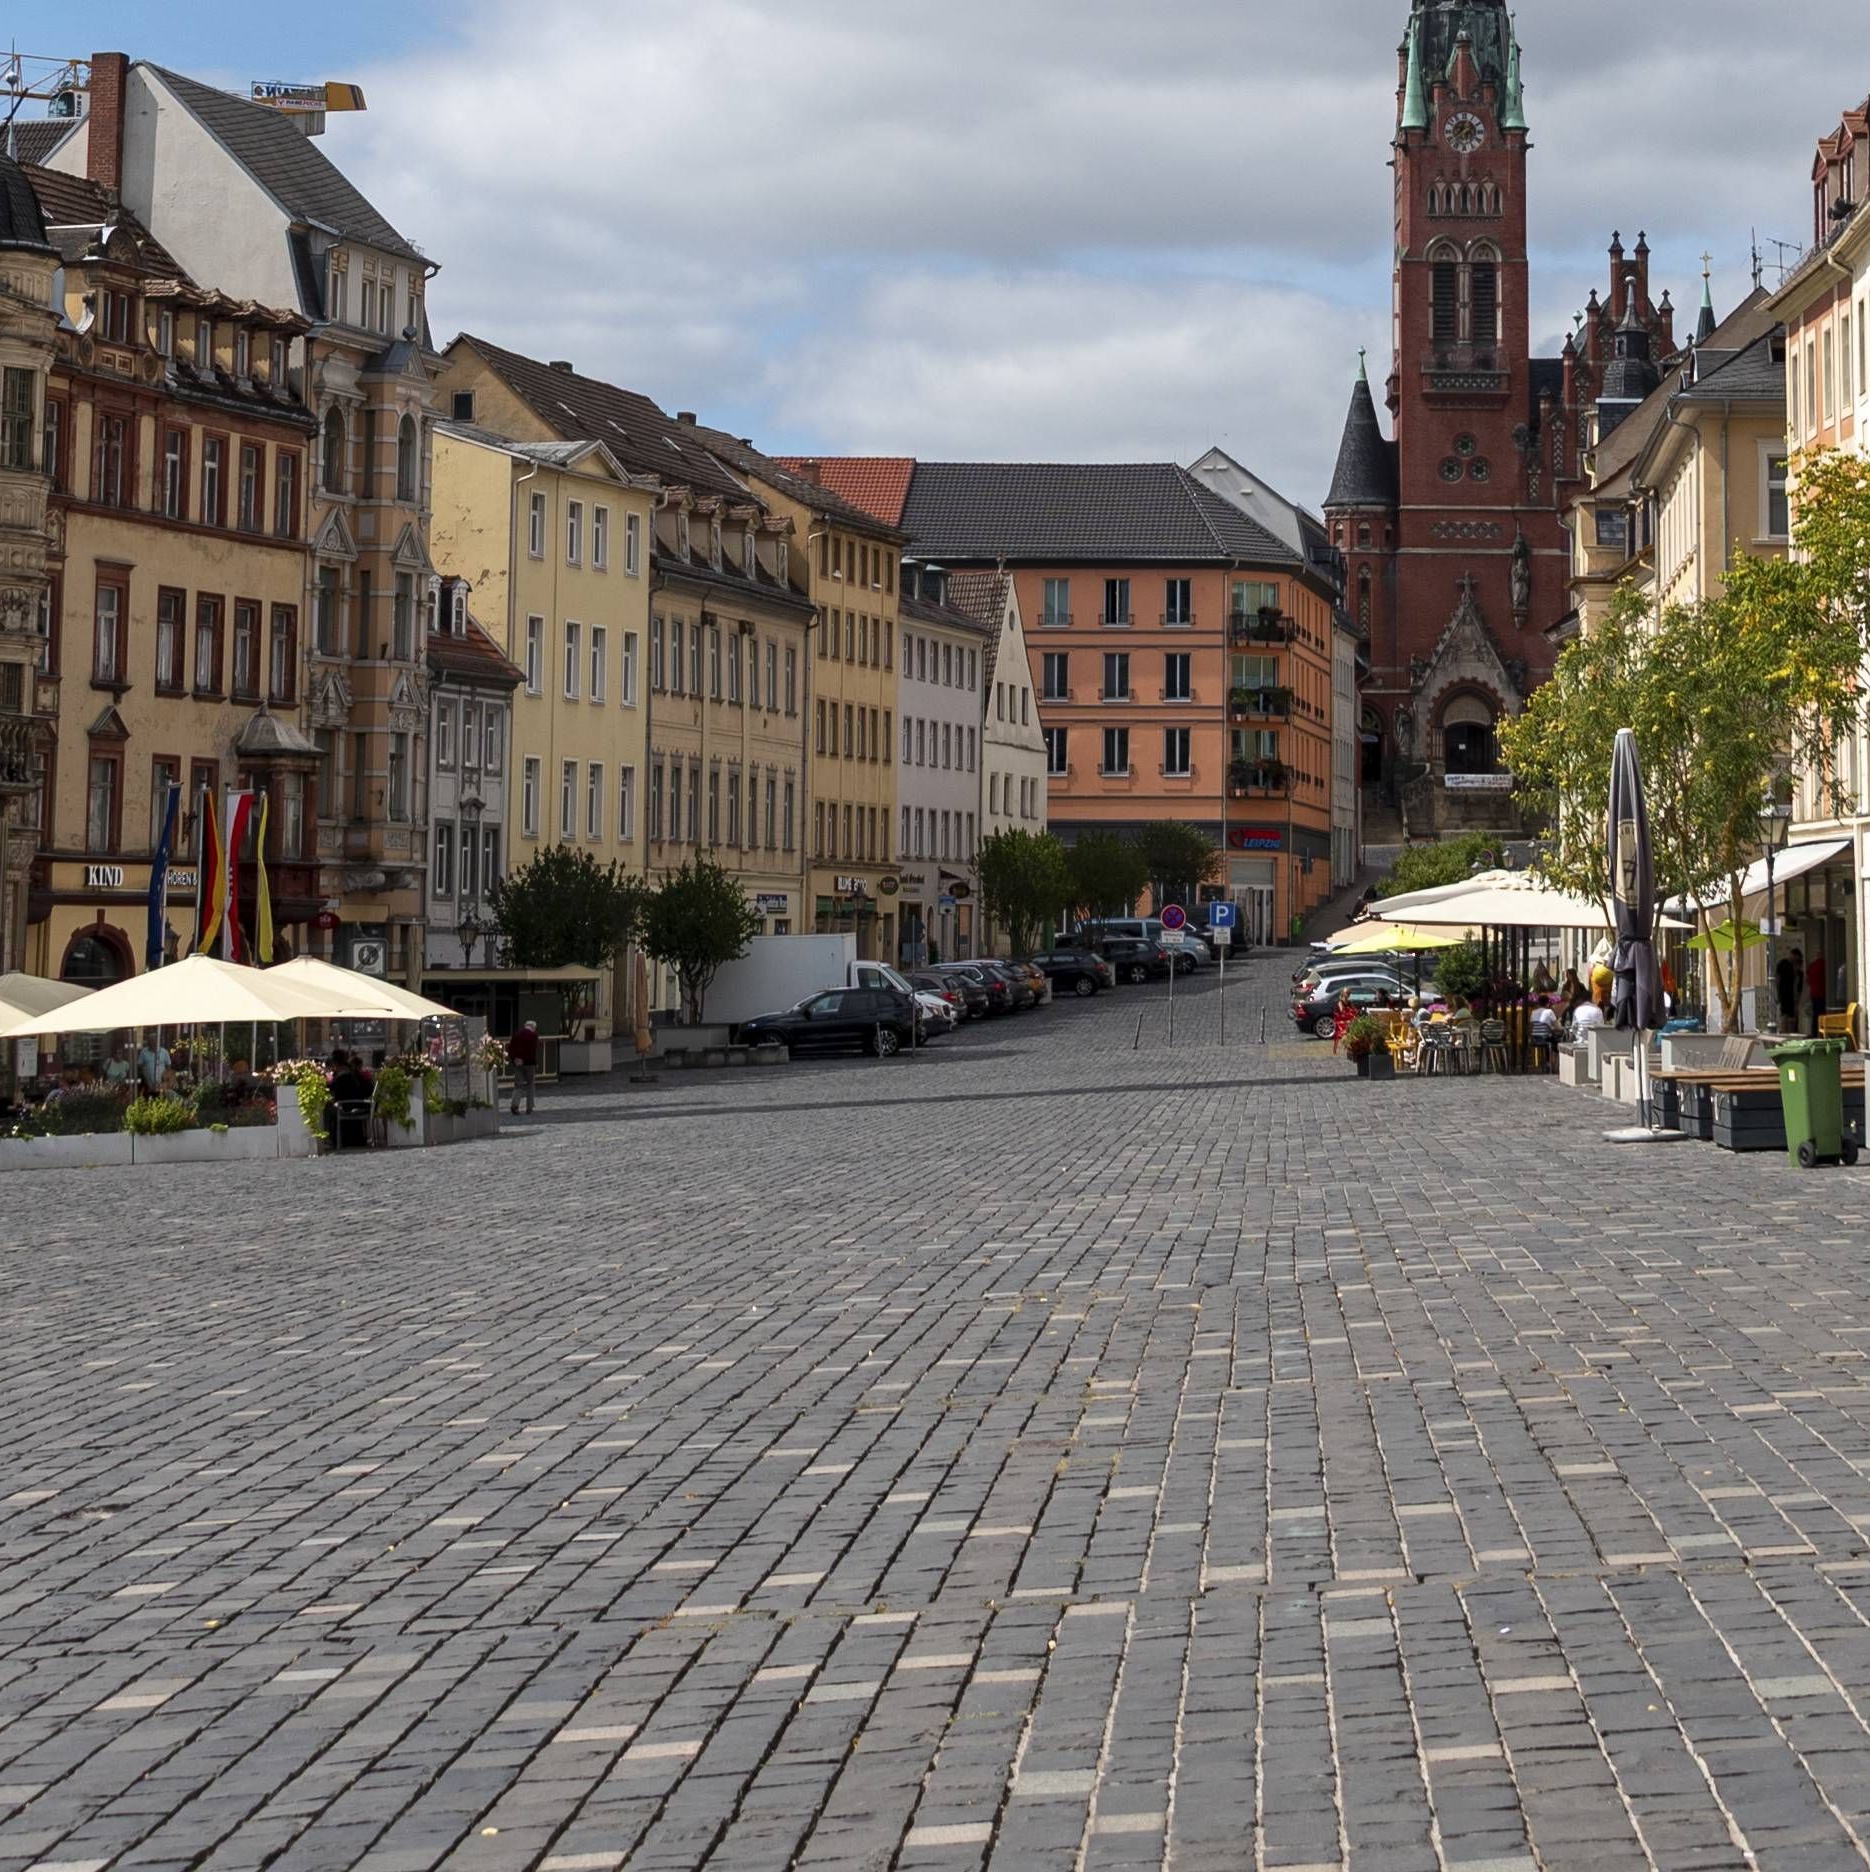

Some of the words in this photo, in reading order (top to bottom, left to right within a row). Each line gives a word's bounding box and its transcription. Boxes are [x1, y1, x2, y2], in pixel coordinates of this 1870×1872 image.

[1243, 838, 1282, 848] LEIPZIG
[88, 865, 124, 887] KIND
[1216, 905, 1229, 924] P
